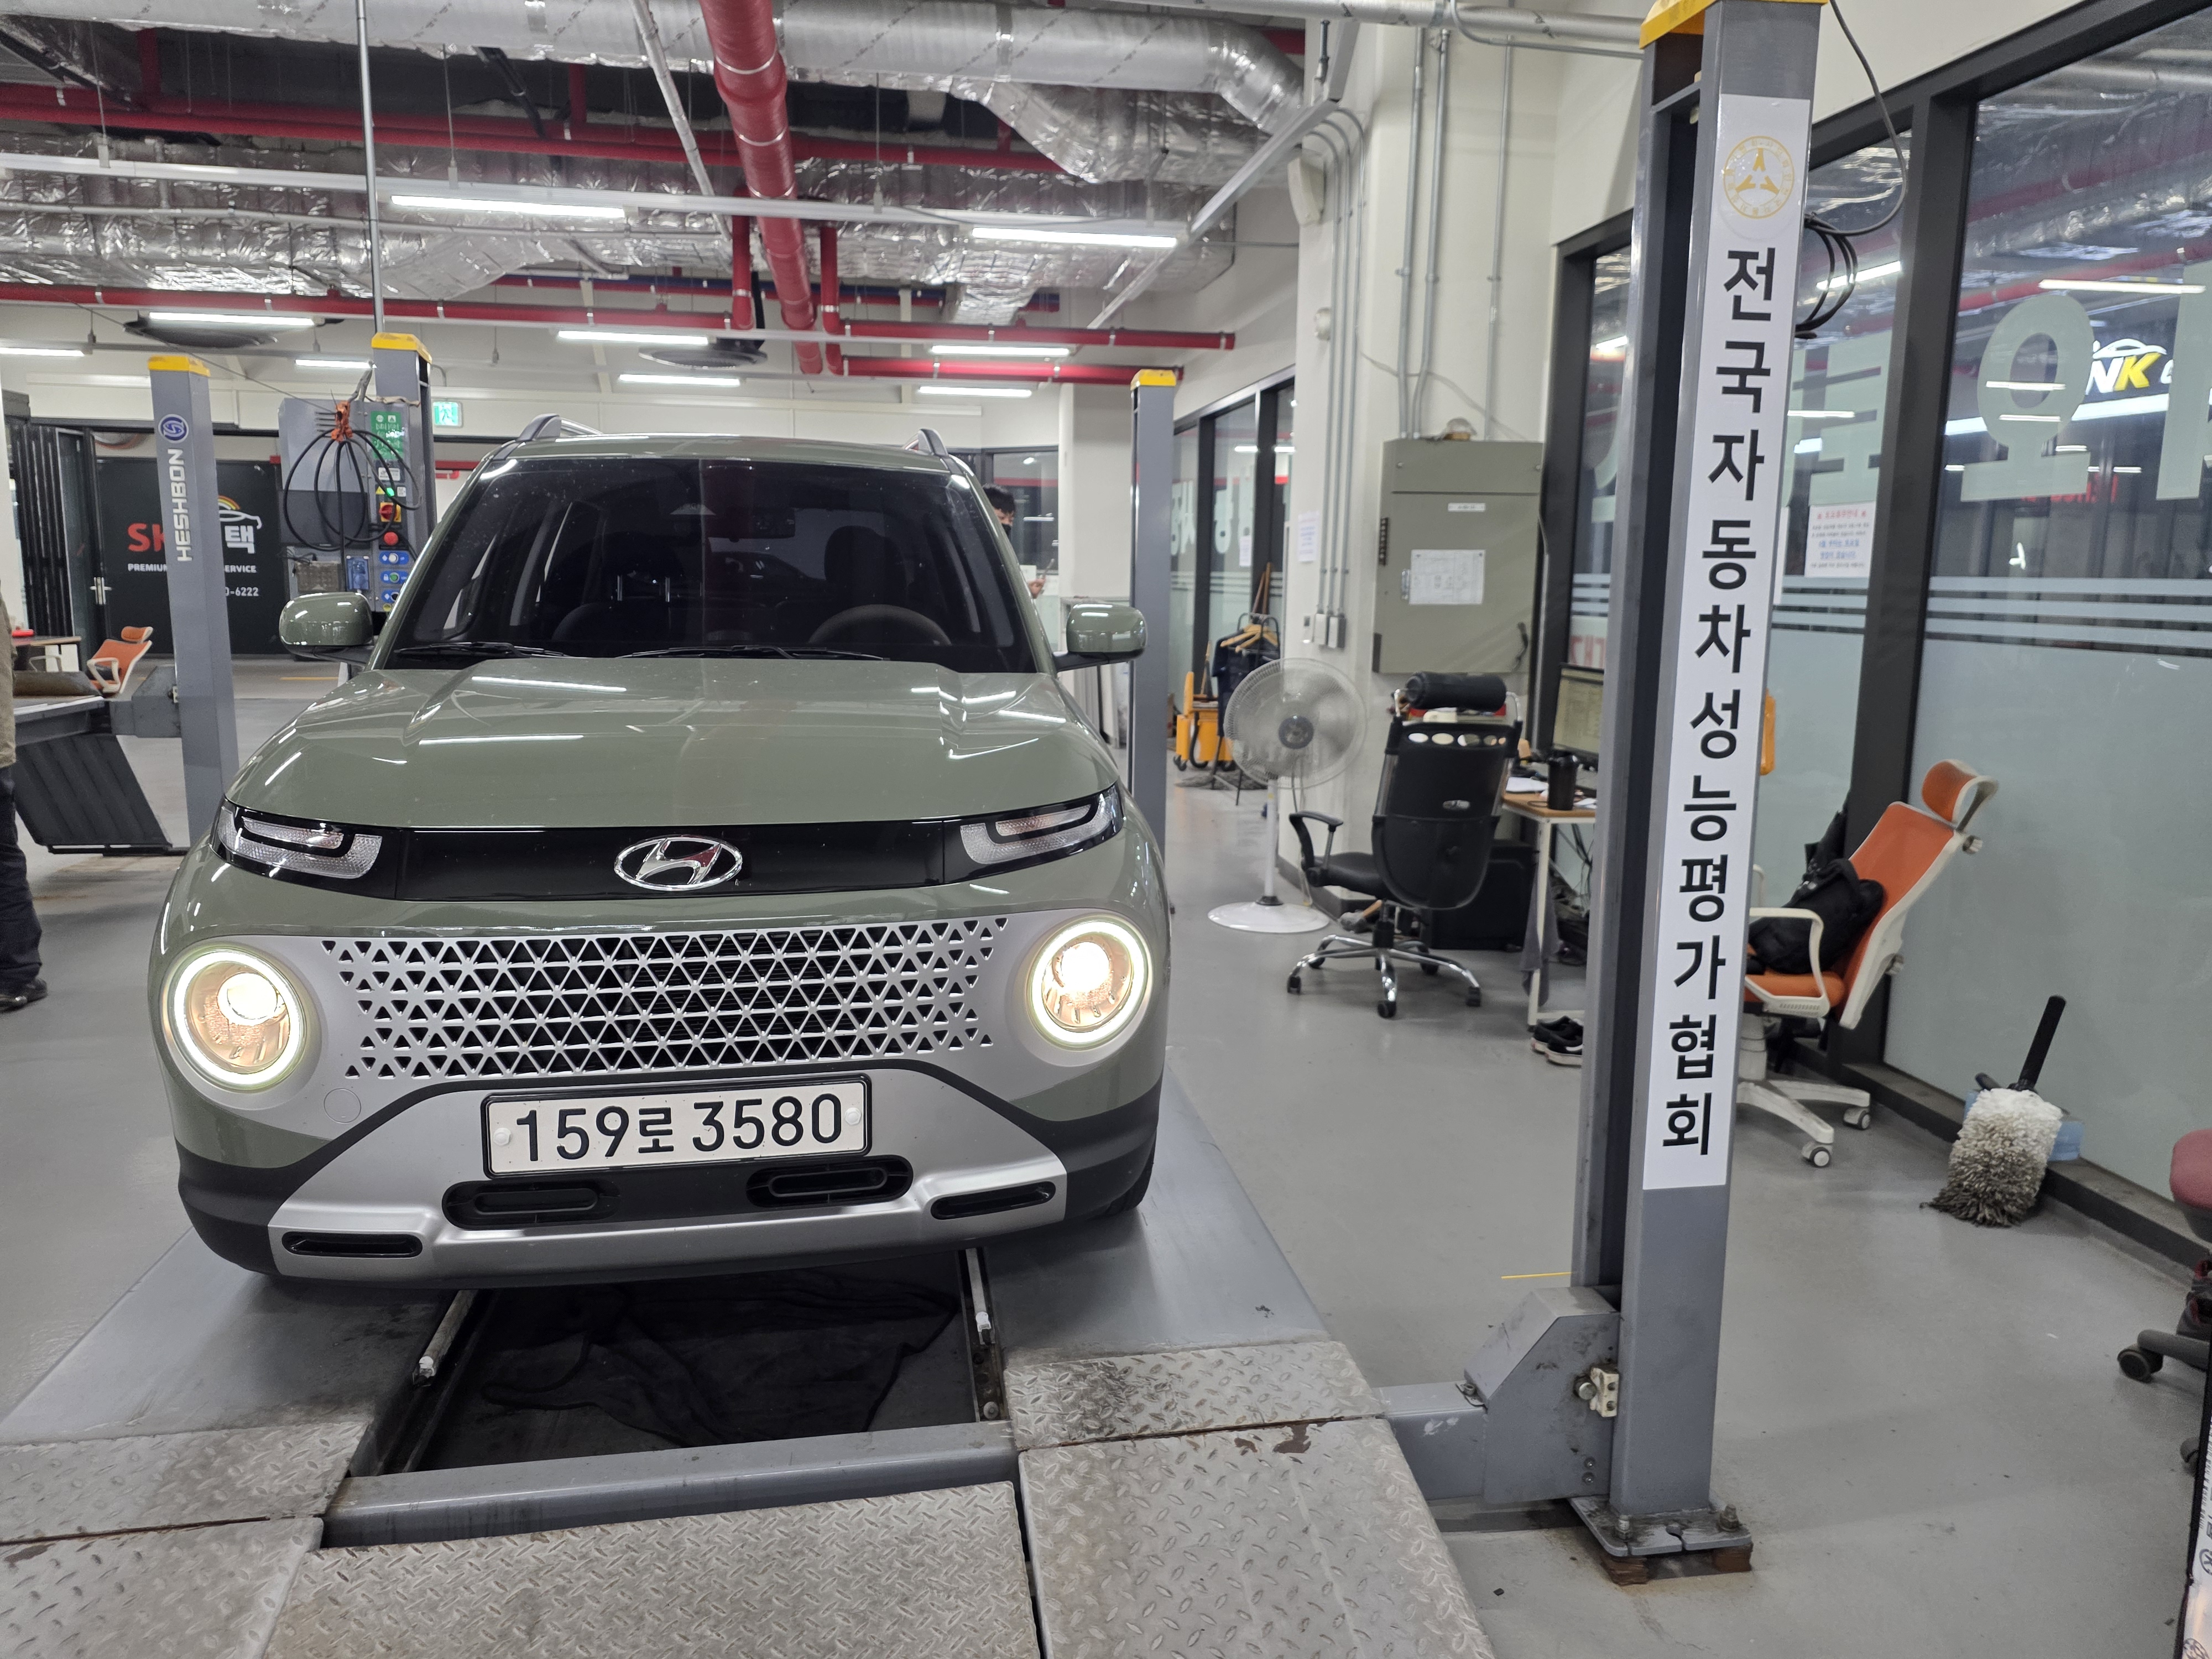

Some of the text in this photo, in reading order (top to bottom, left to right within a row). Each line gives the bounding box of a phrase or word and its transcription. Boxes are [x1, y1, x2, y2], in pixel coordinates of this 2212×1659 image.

[168, 448, 192, 562] HESHBON
[1662, 247, 1776, 1156] 전국자동차성능평가협회
[516, 1093, 842, 1162] 159로 3580
